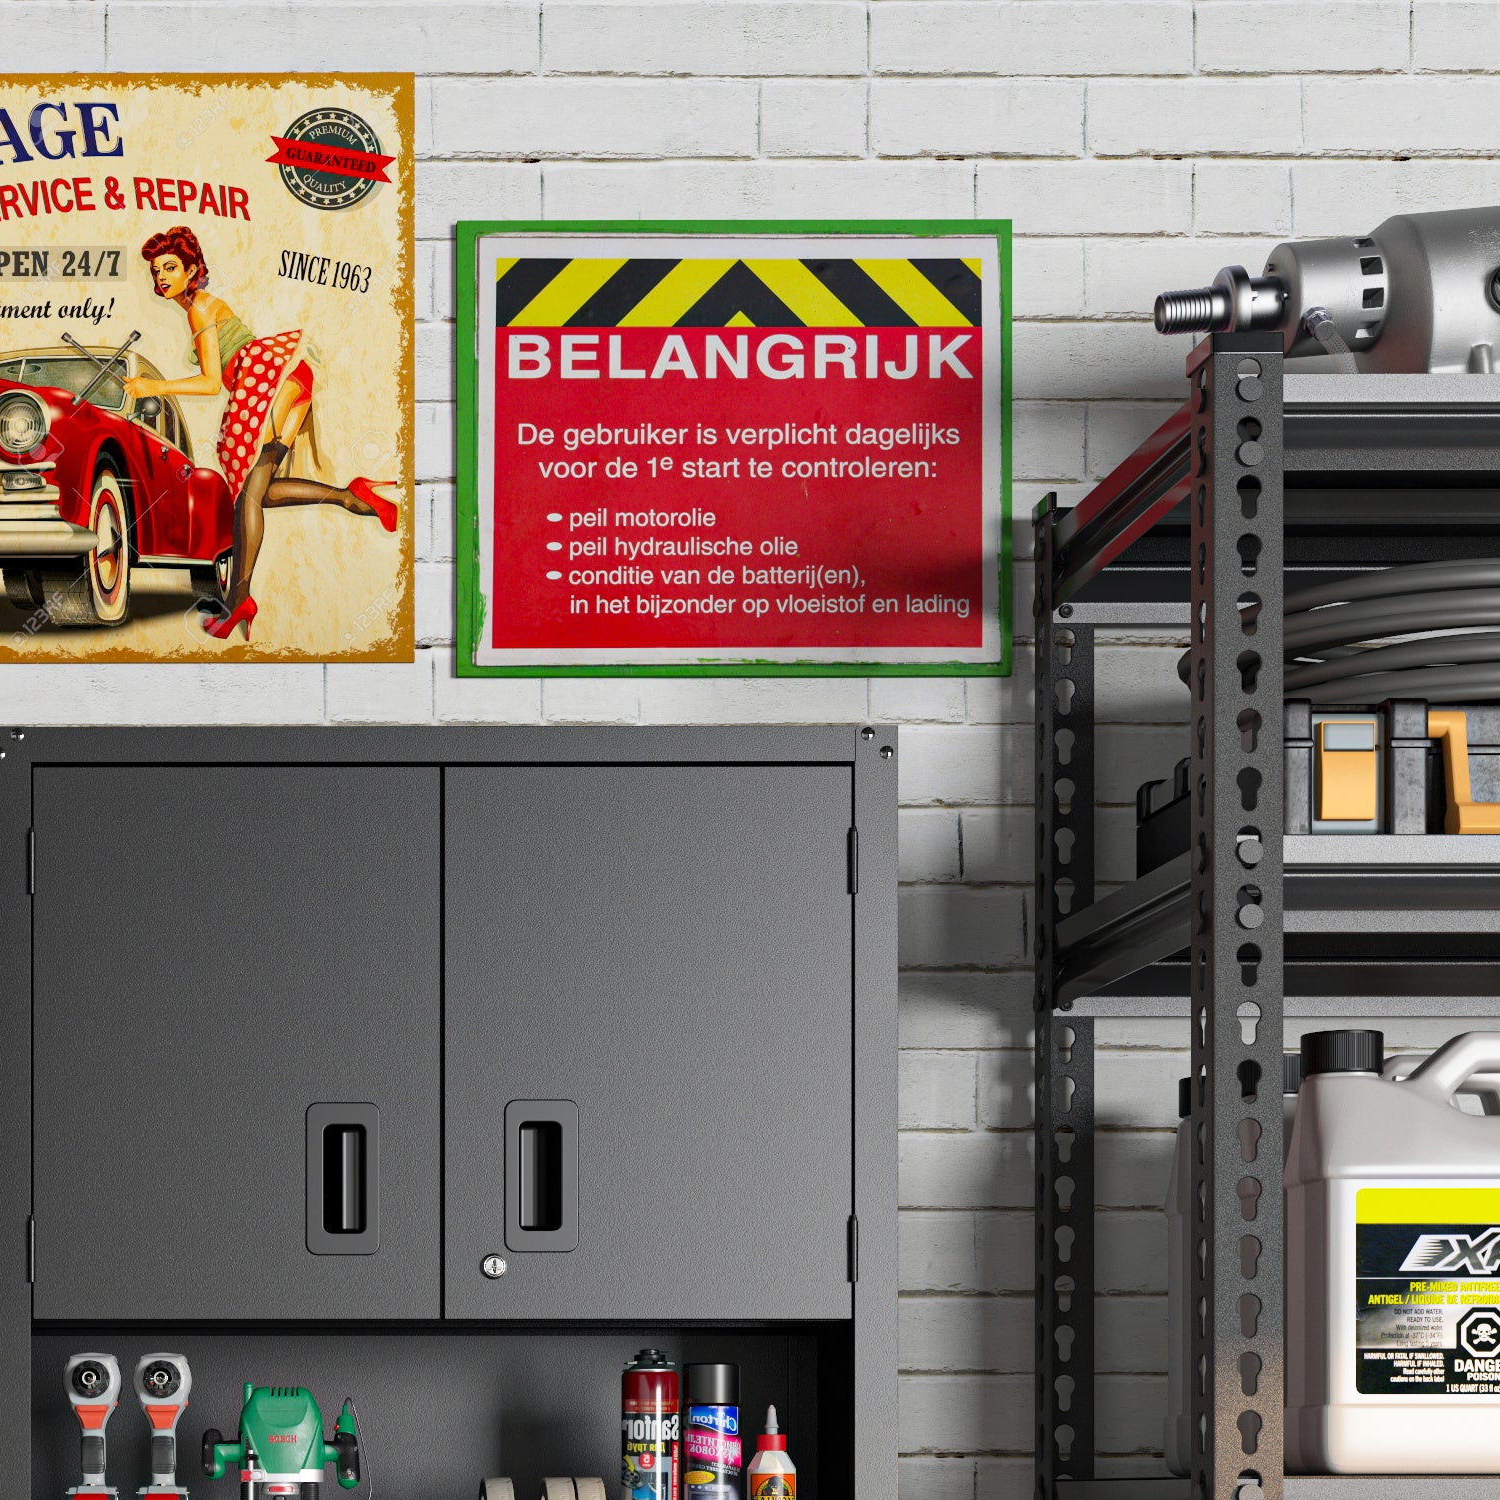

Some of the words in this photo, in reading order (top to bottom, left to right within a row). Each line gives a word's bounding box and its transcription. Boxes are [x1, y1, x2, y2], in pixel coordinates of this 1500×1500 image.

[308, 124, 359, 147] PREMIUM
[284, 145, 378, 175] GUARANTEED
[302, 173, 348, 193] QUALITY
[104, 176, 126, 210] &
[134, 176, 252, 222] REPAIR
[61, 249, 121, 279] 24/7
[277, 249, 329, 288] SINCE
[331, 259, 373, 296] 1963
[57, 296, 116, 326] only!
[507, 333, 975, 380] BELANGRIJK
[516, 423, 555, 446] De
[563, 422, 688, 450] gebruiker
[696, 423, 718, 446] is
[725, 422, 838, 450] verplicht
[845, 422, 961, 450] dagelijks
[538, 461, 598, 479] voor
[604, 456, 638, 479] de
[647, 455, 674, 479] 1e
[681, 457, 741, 479] start
[748, 458, 773, 479] te
[781, 456, 938, 479] controleren:
[568, 508, 608, 531] peil
[614, 507, 717, 528] motorolie
[568, 537, 608, 560] peil
[613, 536, 754, 560] hydraulische
[759, 536, 799, 556] olie
[567, 565, 655, 586] conditie
[660, 569, 701, 586] van
[707, 565, 736, 586] de
[741, 564, 867, 591] batterij(en),
[569, 593, 589, 615] in
[595, 593, 630, 615] het
[635, 593, 736, 620] bijzonder
[741, 598, 770, 620] op
[775, 593, 866, 615] vloeistof
[872, 598, 899, 615] en
[905, 593, 971, 620] lading
[1367, 1294, 1404, 1305] ANTIGEL
[268, 1433, 298, 1444] BOSCH
